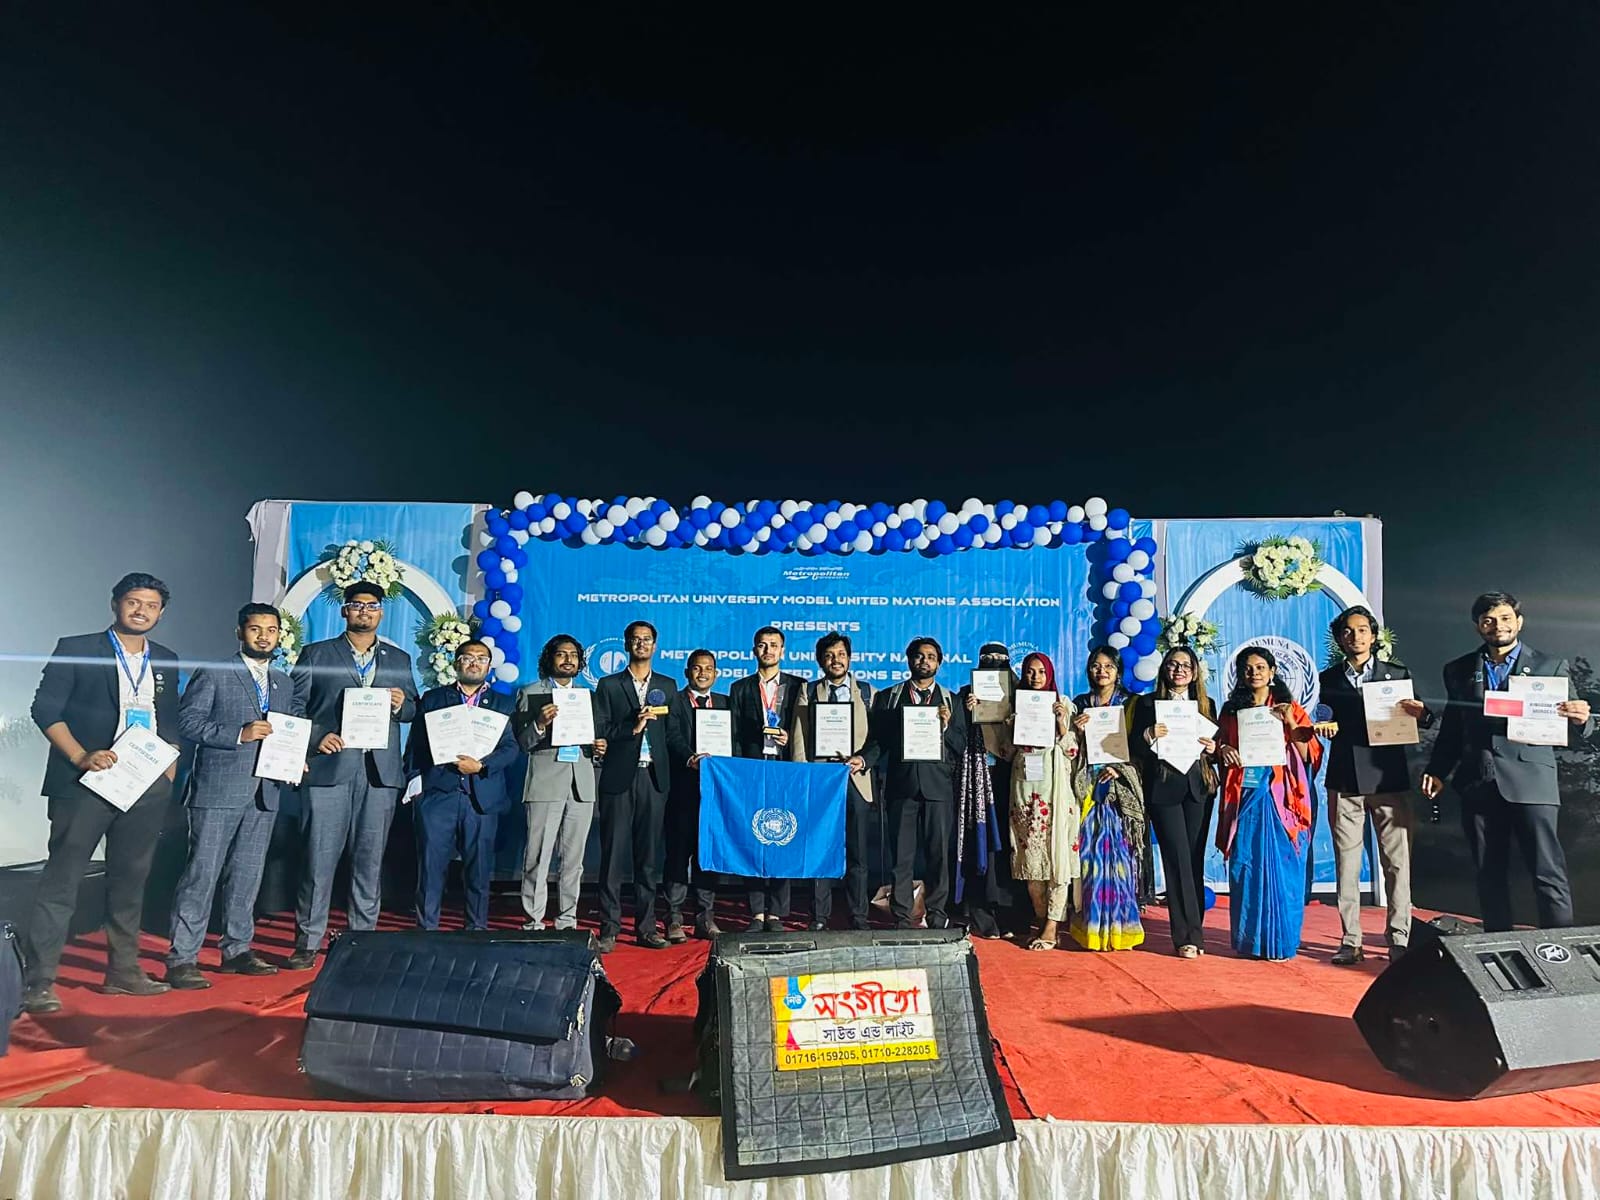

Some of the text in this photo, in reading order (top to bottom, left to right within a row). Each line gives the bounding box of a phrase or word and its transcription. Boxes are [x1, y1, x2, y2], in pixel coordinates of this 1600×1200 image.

[577, 593, 1060, 608] METROPOLITAN UNIVERSITY MODEL UNITED NATIONS ASSOCIATION
[771, 621, 860, 632] PRESENTS
[789, 651, 887, 662] UNISITY
[885, 1021, 916, 1038] লাইট
[785, 1044, 932, 1065] 01716-159205, 01710-228205
